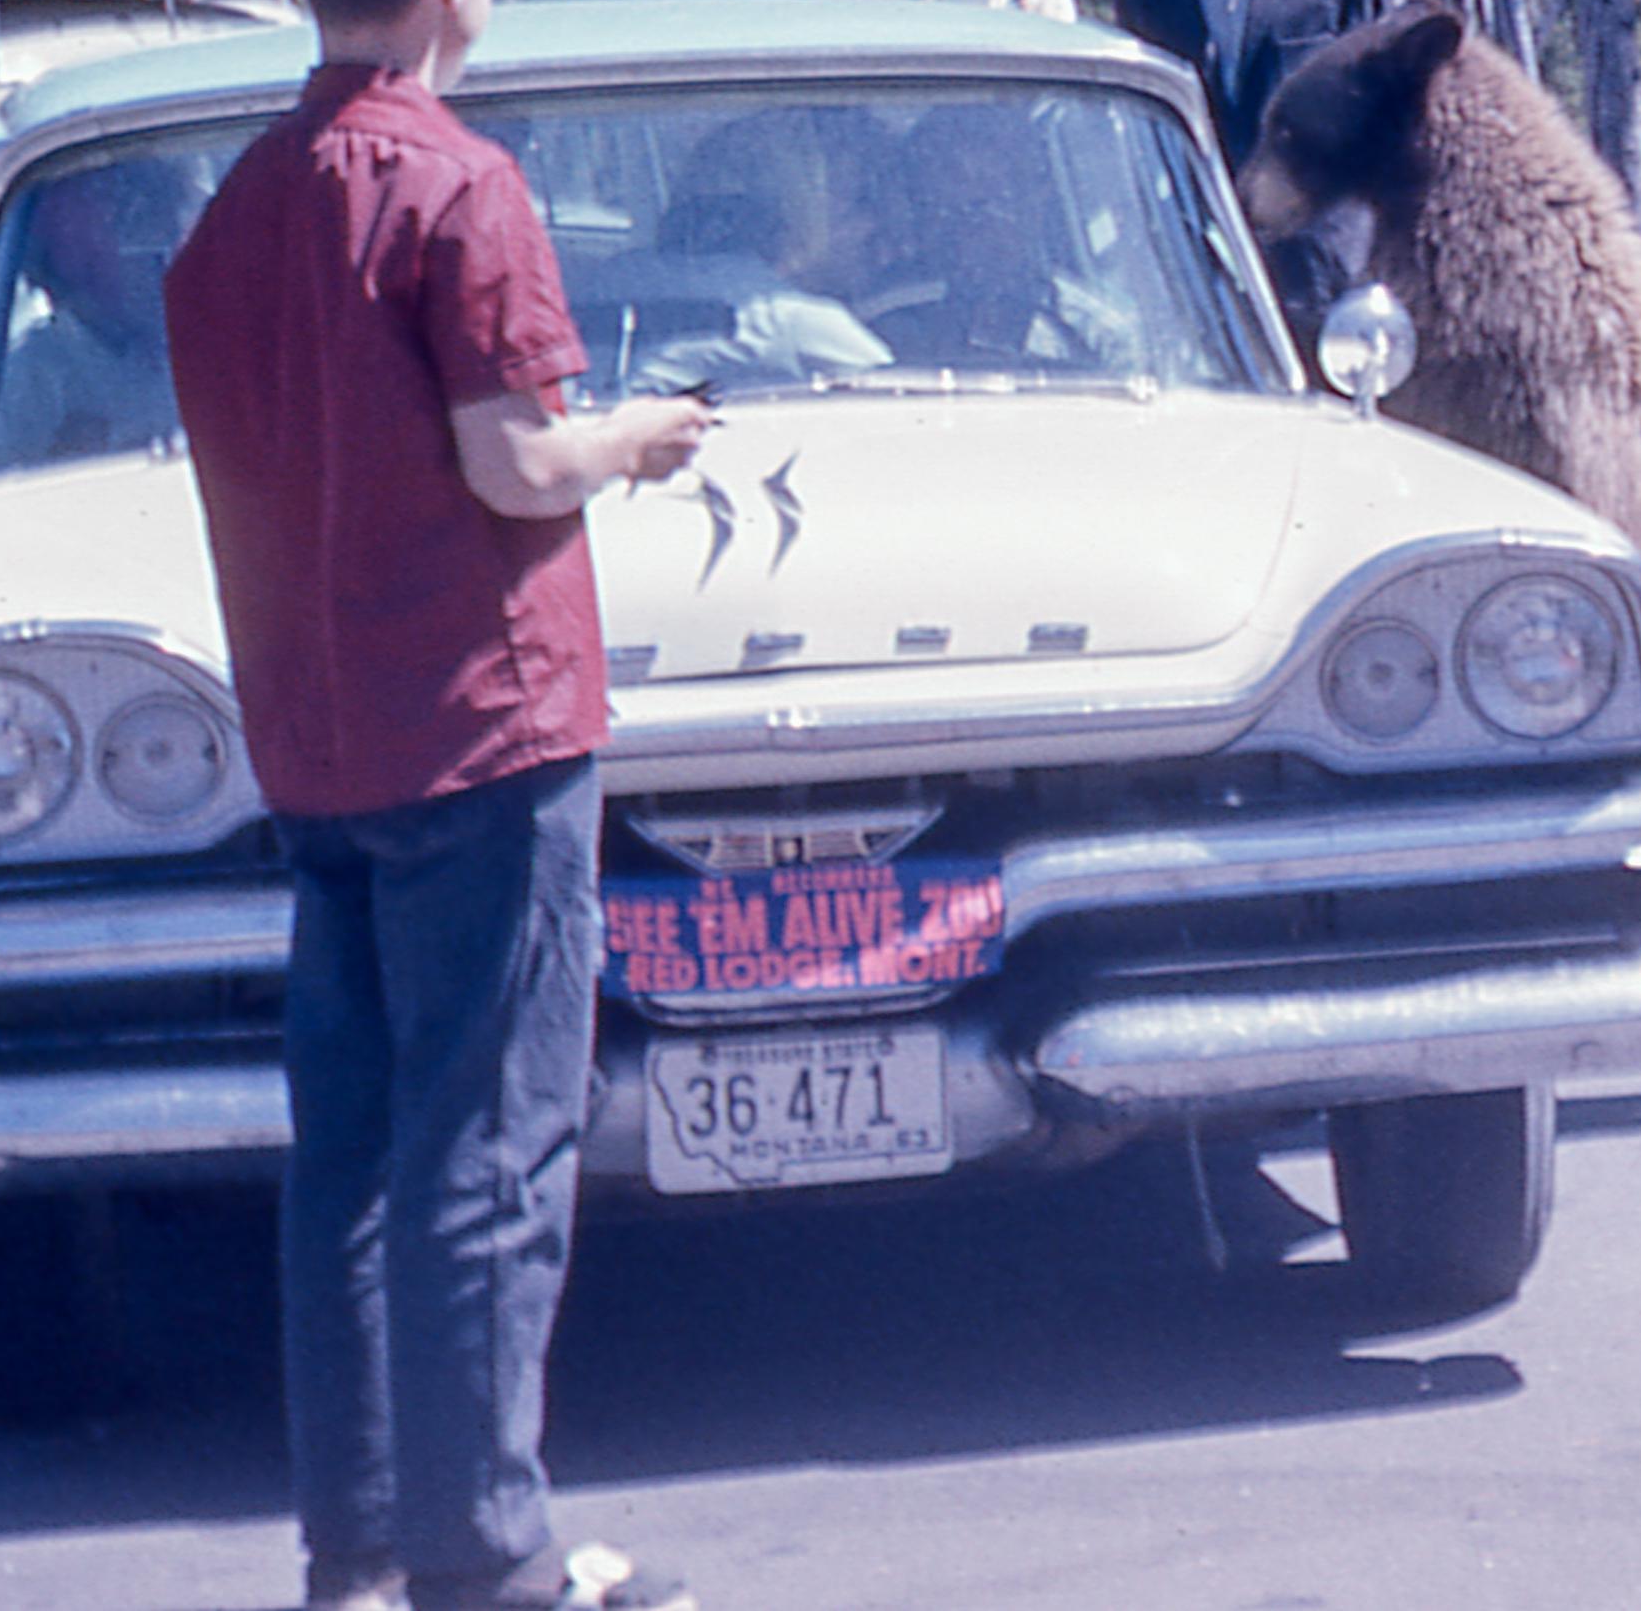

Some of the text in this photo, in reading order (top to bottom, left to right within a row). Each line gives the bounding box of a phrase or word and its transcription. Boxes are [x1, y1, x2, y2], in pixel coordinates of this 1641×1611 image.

[607, 900, 680, 955] SEE
[782, 889, 903, 949] ALIVE
[627, 953, 698, 992] RED
[859, 940, 987, 986] MONT.
[688, 1063, 895, 1137] 36 471
[730, 1133, 870, 1159] MONTANA
